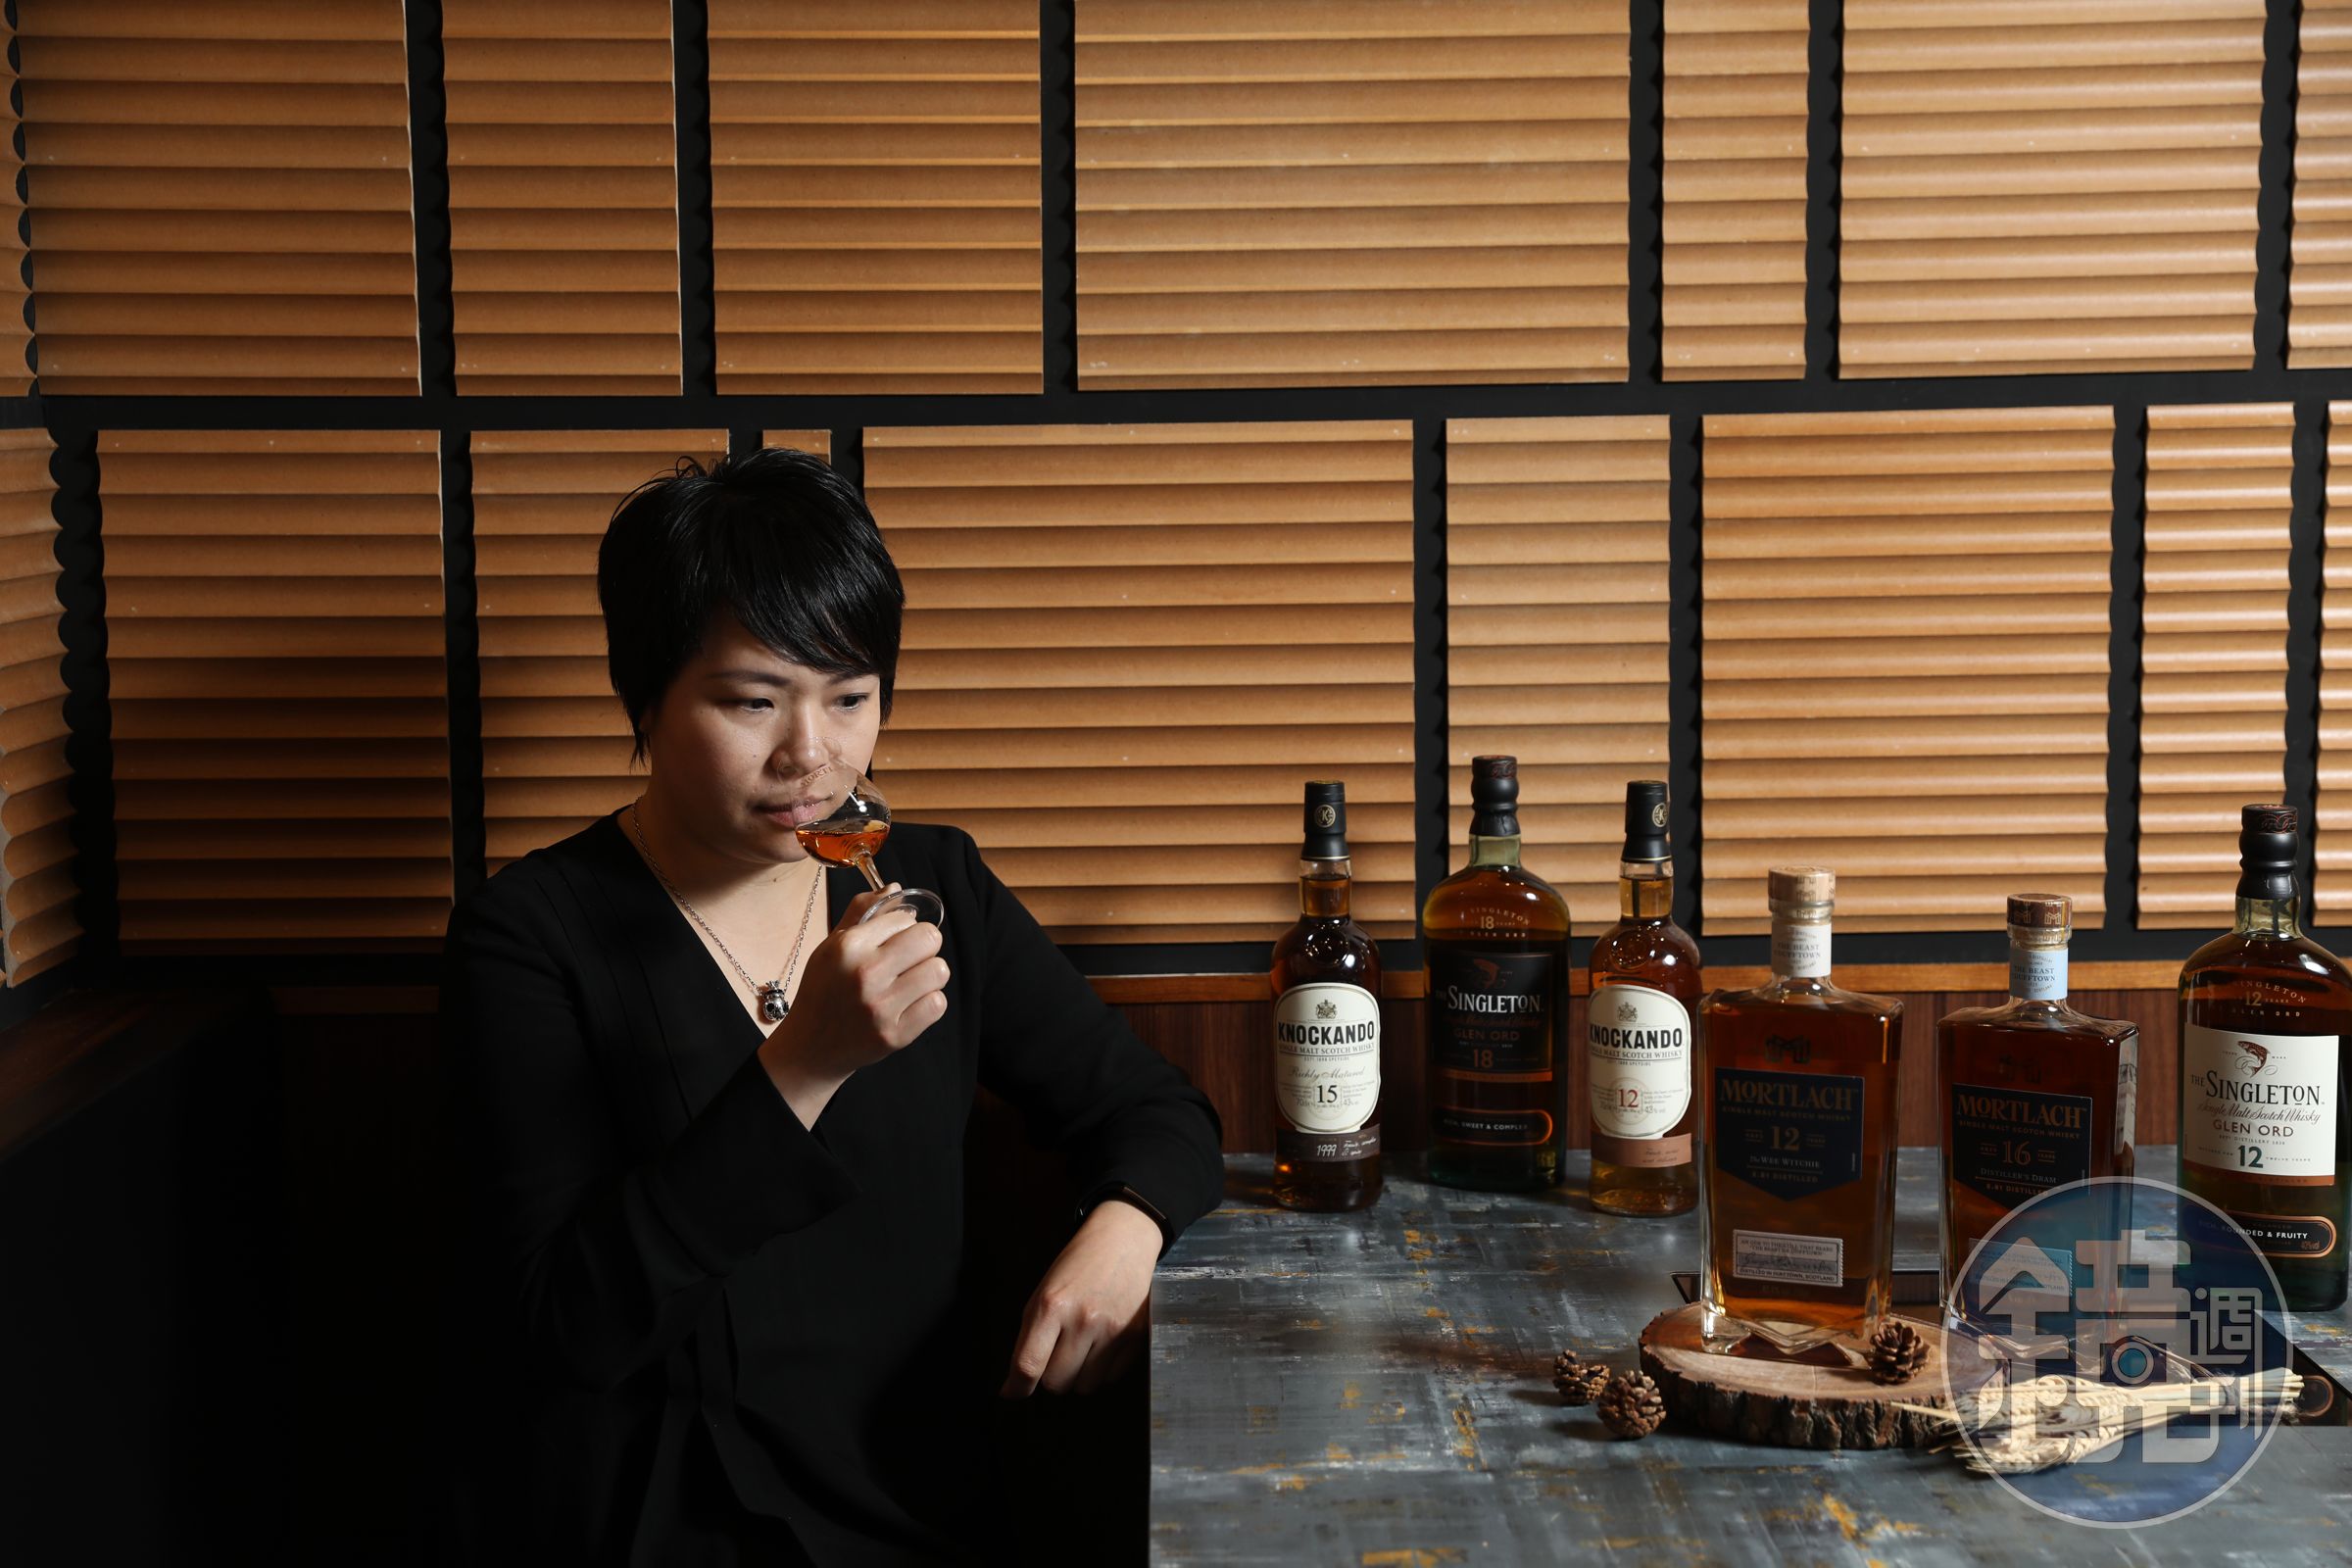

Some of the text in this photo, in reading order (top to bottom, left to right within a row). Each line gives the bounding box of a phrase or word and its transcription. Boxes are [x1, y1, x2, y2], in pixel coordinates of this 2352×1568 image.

[1481, 915, 1494, 929] 18
[1447, 985, 1541, 1013] SINGLETON
[2244, 991, 2263, 1006] 12
[1277, 1020, 1375, 1046] KNOCKANDO
[1299, 1046, 1319, 1054] MALT
[1321, 1046, 1350, 1055] SCOTCH
[1473, 1049, 1494, 1068] 18
[1622, 1051, 1652, 1059] SCOTCH
[1654, 1050, 1683, 1058] WHISKY
[1317, 1084, 1339, 1103] 15
[1720, 1078, 1853, 1112] MORTLACH
[2191, 1070, 2321, 1105] THE SINGLETON
[1617, 1089, 1639, 1108] 12
[1956, 1093, 2082, 1130] MORTLACH
[2228, 1102, 2250, 1118] Malt
[2248, 1105, 2284, 1122] Scotch
[2283, 1107, 2321, 1125] Whisky
[2213, 1119, 2294, 1138] GLEN ORD
[1771, 1125, 1801, 1152] 12
[1316, 1144, 1338, 1157] 1999
[2002, 1139, 2031, 1166] 16
[2237, 1145, 2264, 1168] 12
[2276, 1231, 2309, 1240] FRUITY
